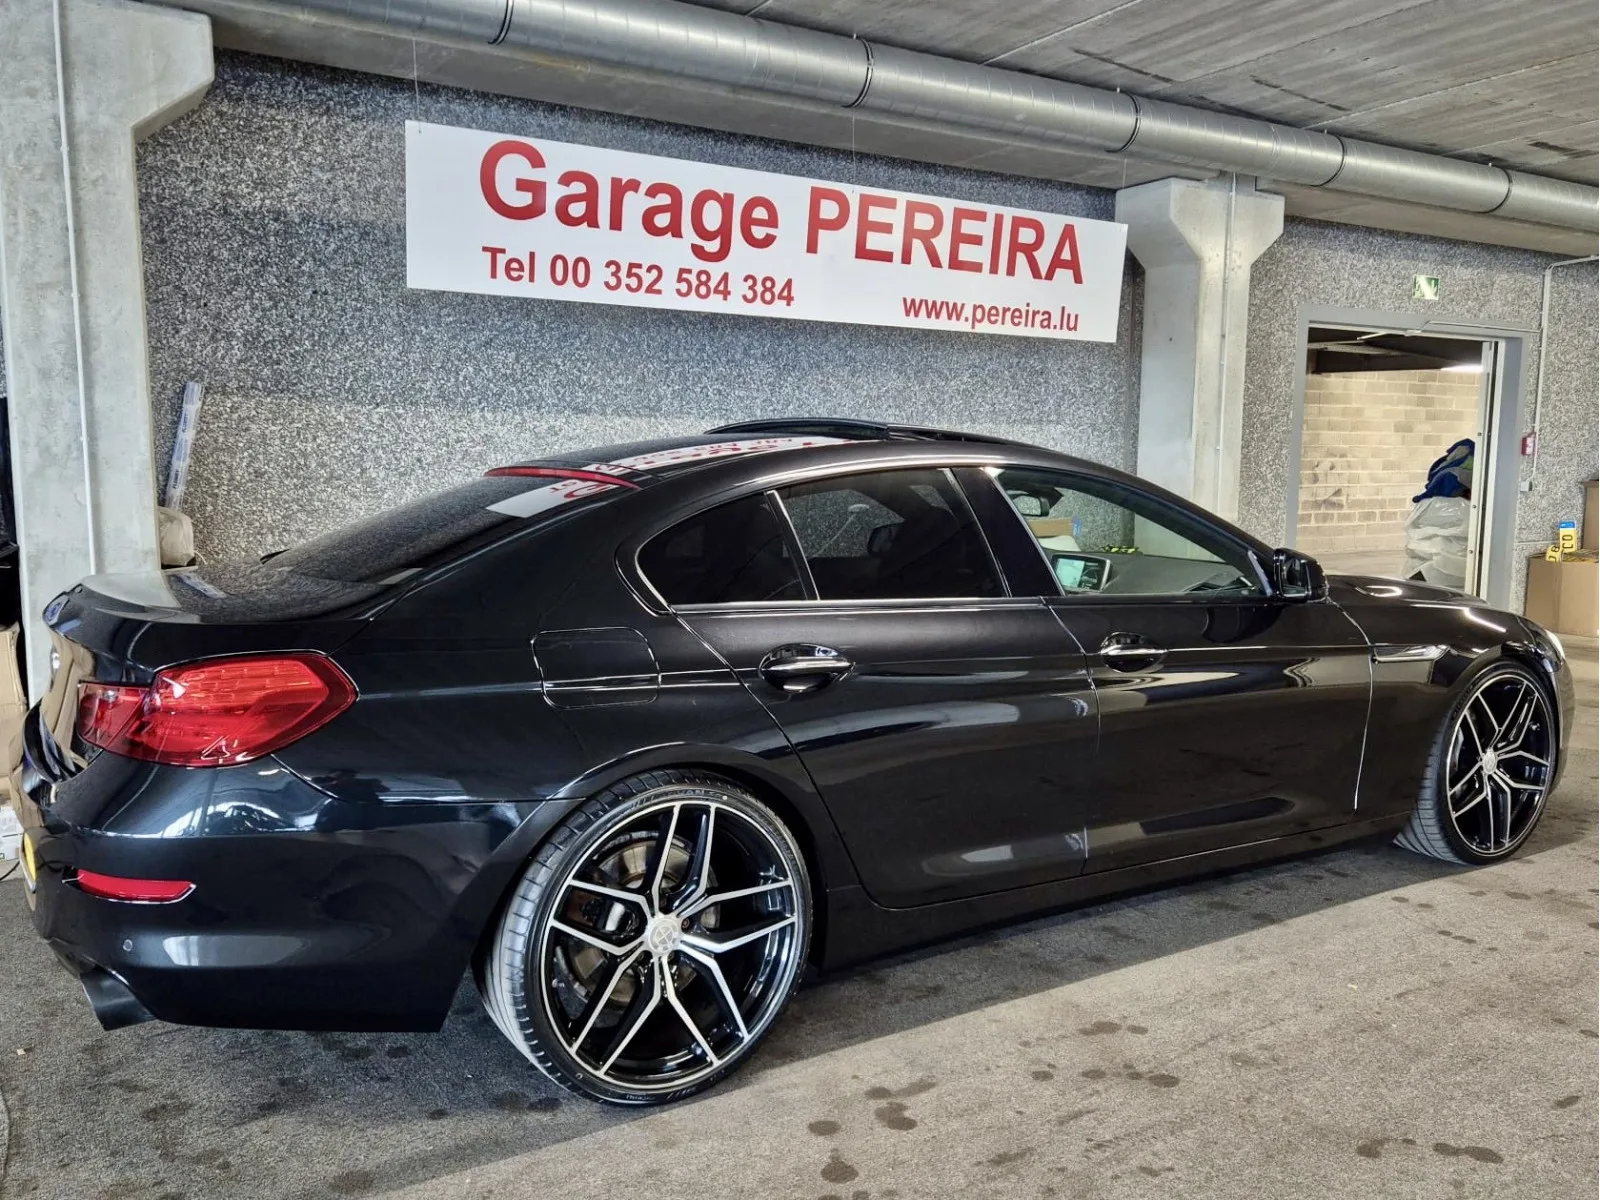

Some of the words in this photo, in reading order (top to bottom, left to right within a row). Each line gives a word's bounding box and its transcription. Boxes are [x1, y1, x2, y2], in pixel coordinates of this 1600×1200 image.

[479, 139, 780, 264] Garage
[805, 186, 1084, 285] PEREIRA
[482, 246, 536, 283] Tel
[549, 254, 591, 289] 00
[605, 260, 664, 296] 352
[676, 267, 732, 300] 584
[742, 274, 794, 306] 384
[902, 296, 1079, 332] www.pereira.lu
